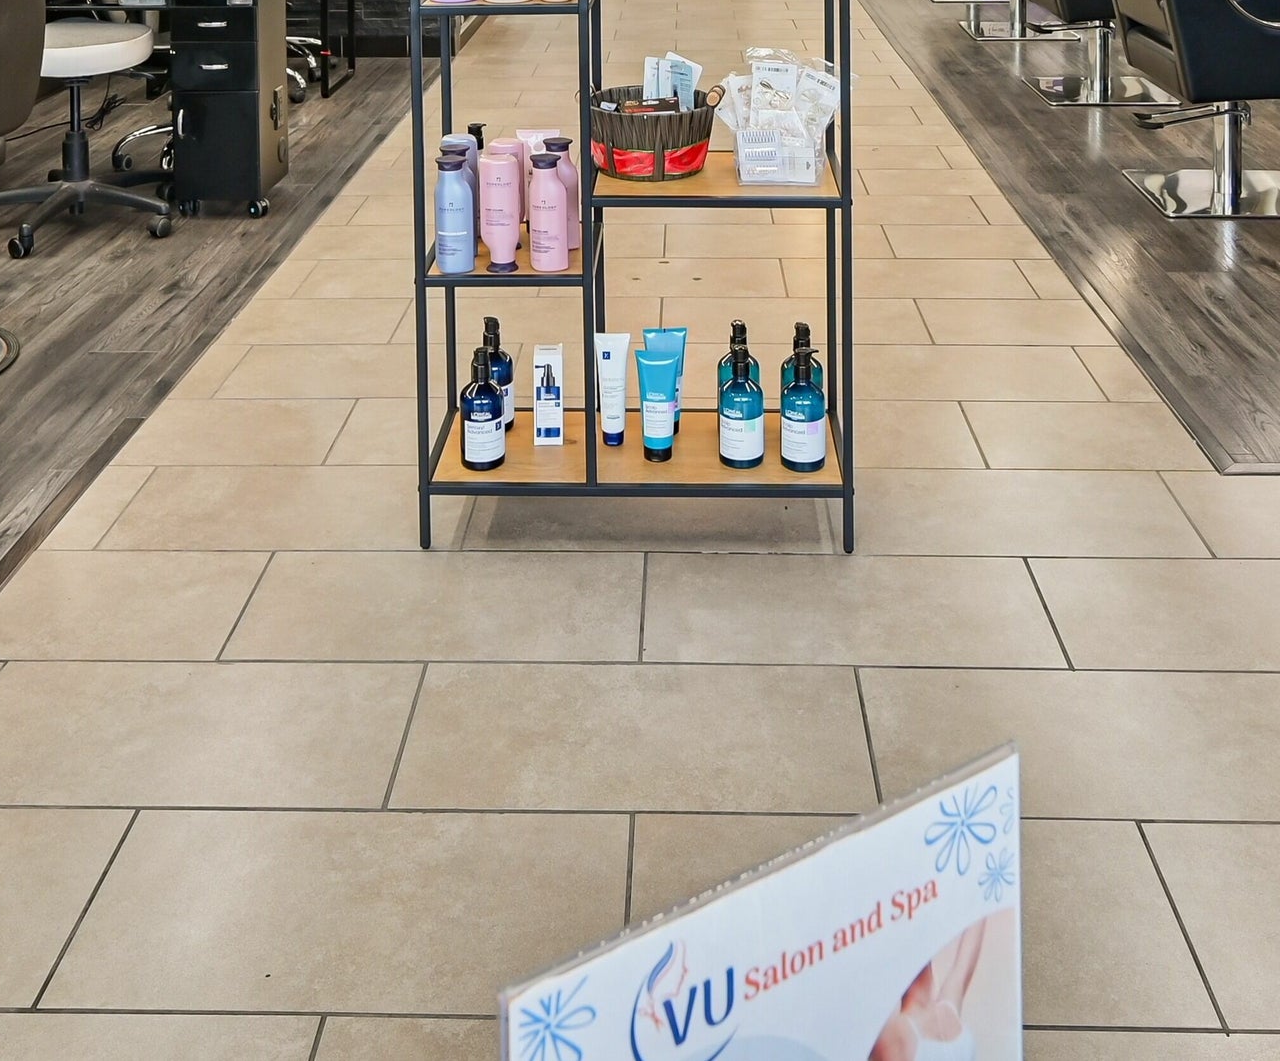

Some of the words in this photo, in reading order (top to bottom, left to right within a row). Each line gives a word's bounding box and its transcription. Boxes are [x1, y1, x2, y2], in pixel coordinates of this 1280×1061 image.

[662, 966, 734, 1046] VU
[742, 936, 825, 1002] Salon
[832, 901, 883, 953] and
[889, 878, 939, 924] Spa
